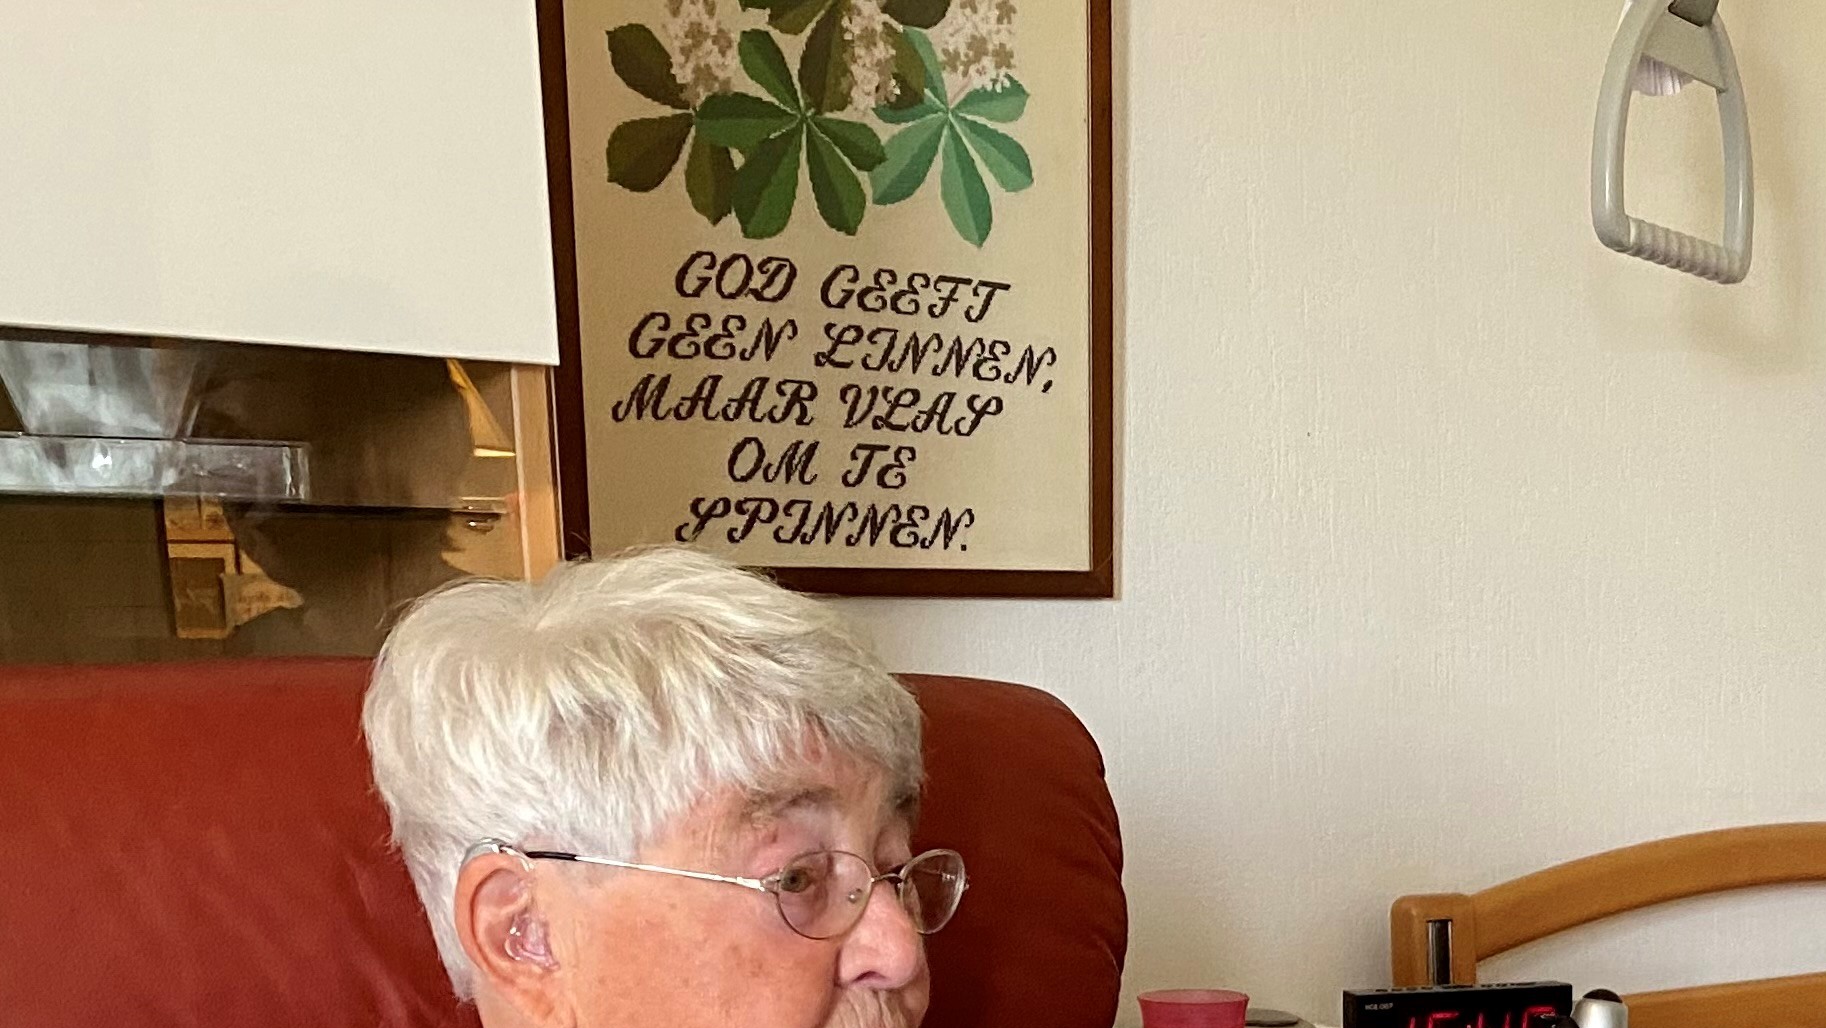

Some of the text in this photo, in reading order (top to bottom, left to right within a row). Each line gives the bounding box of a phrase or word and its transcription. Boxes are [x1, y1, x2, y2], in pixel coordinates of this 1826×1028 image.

[674, 250, 1011, 323] GOD GEEFT
[628, 311, 1057, 394] GEEN LINNEN,
[611, 373, 1004, 437] MAAR VLAS
[727, 436, 917, 490] OM TE
[674, 496, 975, 552] SPINNEN.
